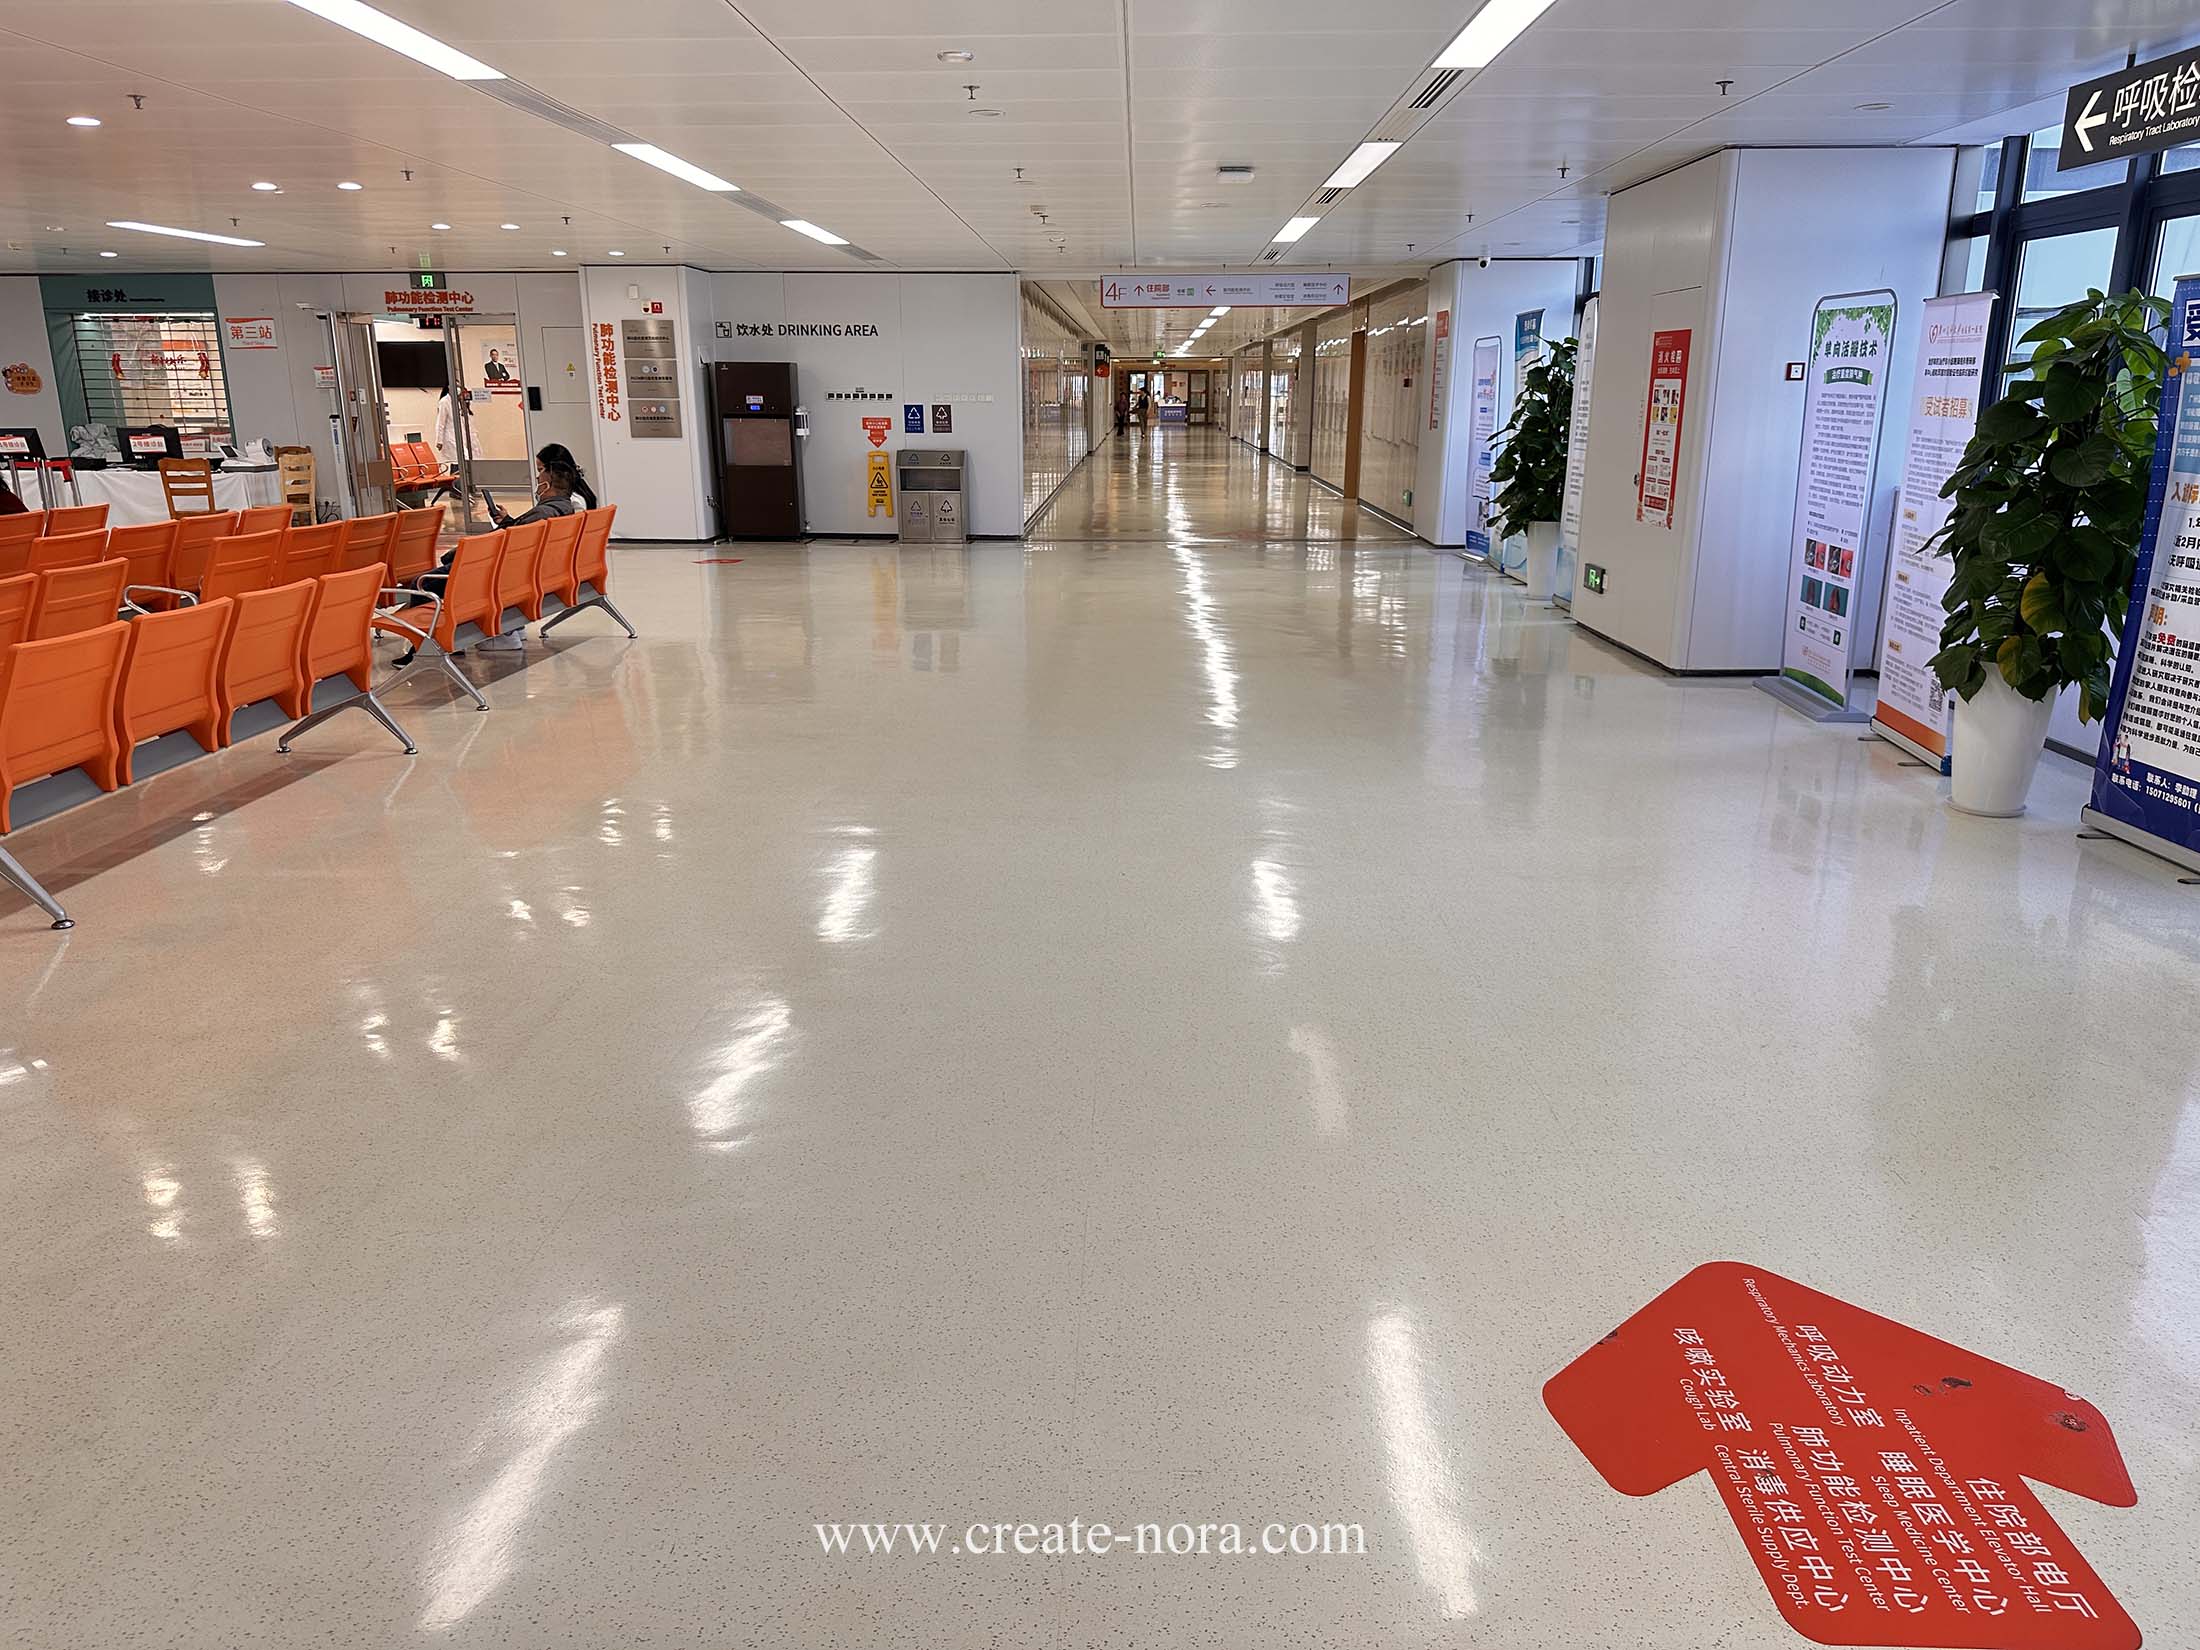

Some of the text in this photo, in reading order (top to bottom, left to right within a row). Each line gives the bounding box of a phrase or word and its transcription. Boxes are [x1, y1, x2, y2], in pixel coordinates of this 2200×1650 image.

[2109, 116, 2200, 146] Respiratory Tract Laboratory
[2112, 60, 2200, 129] 呼吸检
[87, 288, 128, 303] 接诊处
[230, 325, 273, 340] 第三站
[384, 291, 475, 305] 肺功能检测中心
[736, 323, 879, 337] 饮水处 DRINKING AREA
[1105, 282, 1128, 302] 4F
[600, 323, 622, 422] 肺功能检测中心
[1673, 1327, 1753, 1432] 咳嗽实验室
[1743, 1277, 1848, 1427] Respiratory Mechanics Laboratory
[1795, 1325, 1885, 1428] 呼吸动力室
[1680, 1378, 1717, 1431] Cough Lab
[1714, 1444, 1810, 1610] Central Sterile Supply Dept.
[1736, 1448, 1848, 1612] 消毒供应中心
[1769, 1422, 1891, 1612] Pulmonary Function Test Center
[1790, 1425, 1928, 1614] 肺功能检测中心
[1871, 1475, 1971, 1614] Sleep Medicine Center
[1878, 1451, 2009, 1616] 睡眠医学中心
[1893, 1408, 2054, 1612] Inpatient Department Elevator Hall
[1965, 1477, 2100, 1619] 住院部电厅
